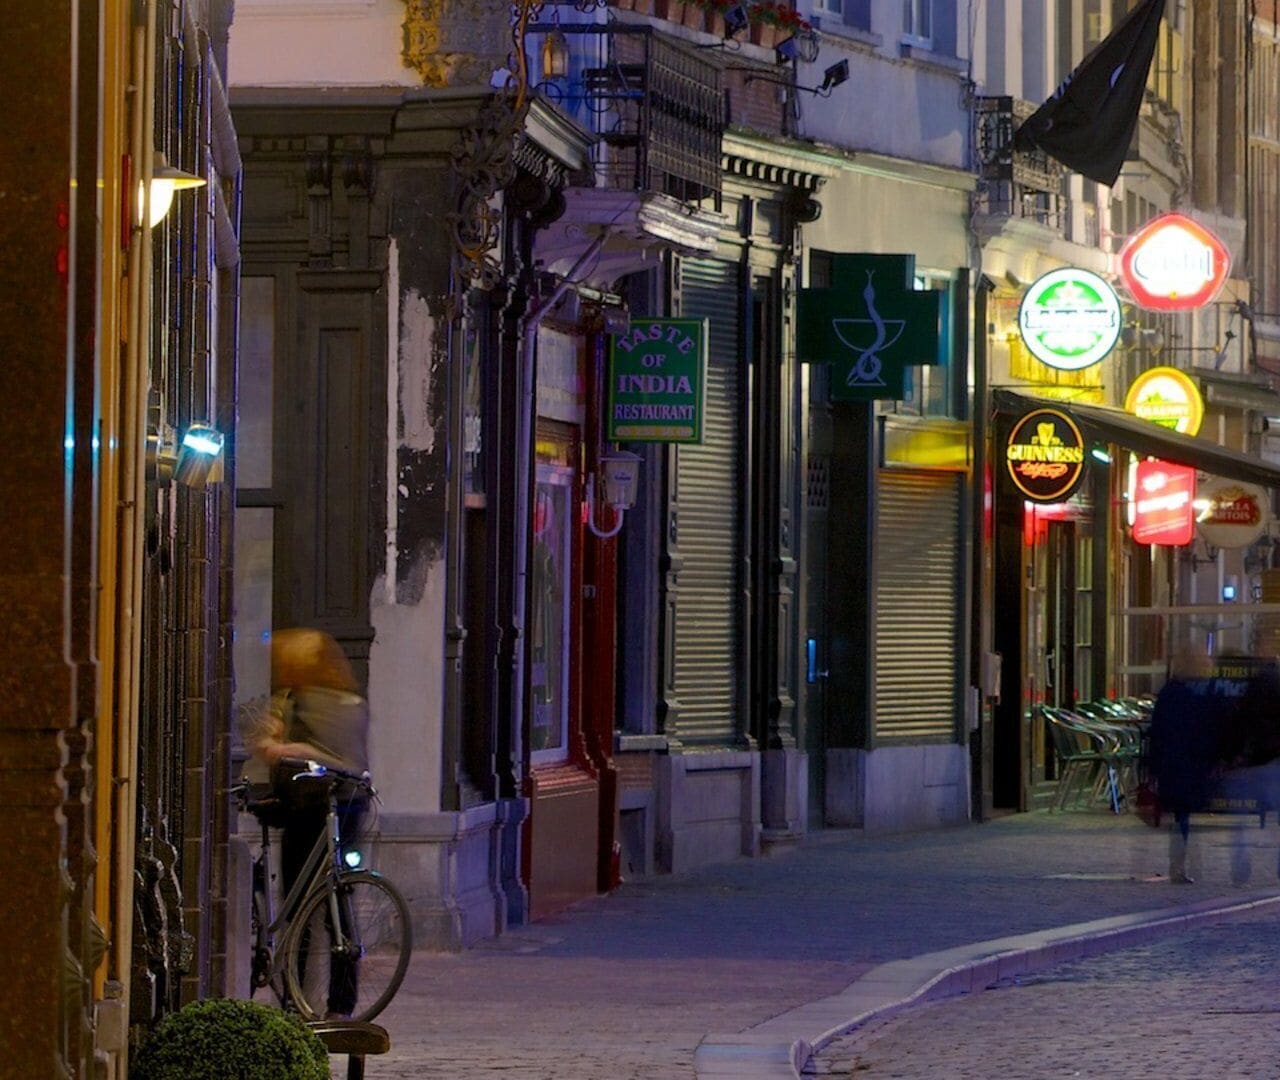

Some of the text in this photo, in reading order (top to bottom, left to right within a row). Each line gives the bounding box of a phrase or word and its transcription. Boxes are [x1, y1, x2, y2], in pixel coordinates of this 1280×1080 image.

[616, 323, 694, 354] TASTE
[641, 353, 666, 368] OF
[617, 374, 693, 394] INDIA
[614, 404, 694, 420] RESTAURANT
[1006, 444, 1084, 462] GUINNESS
